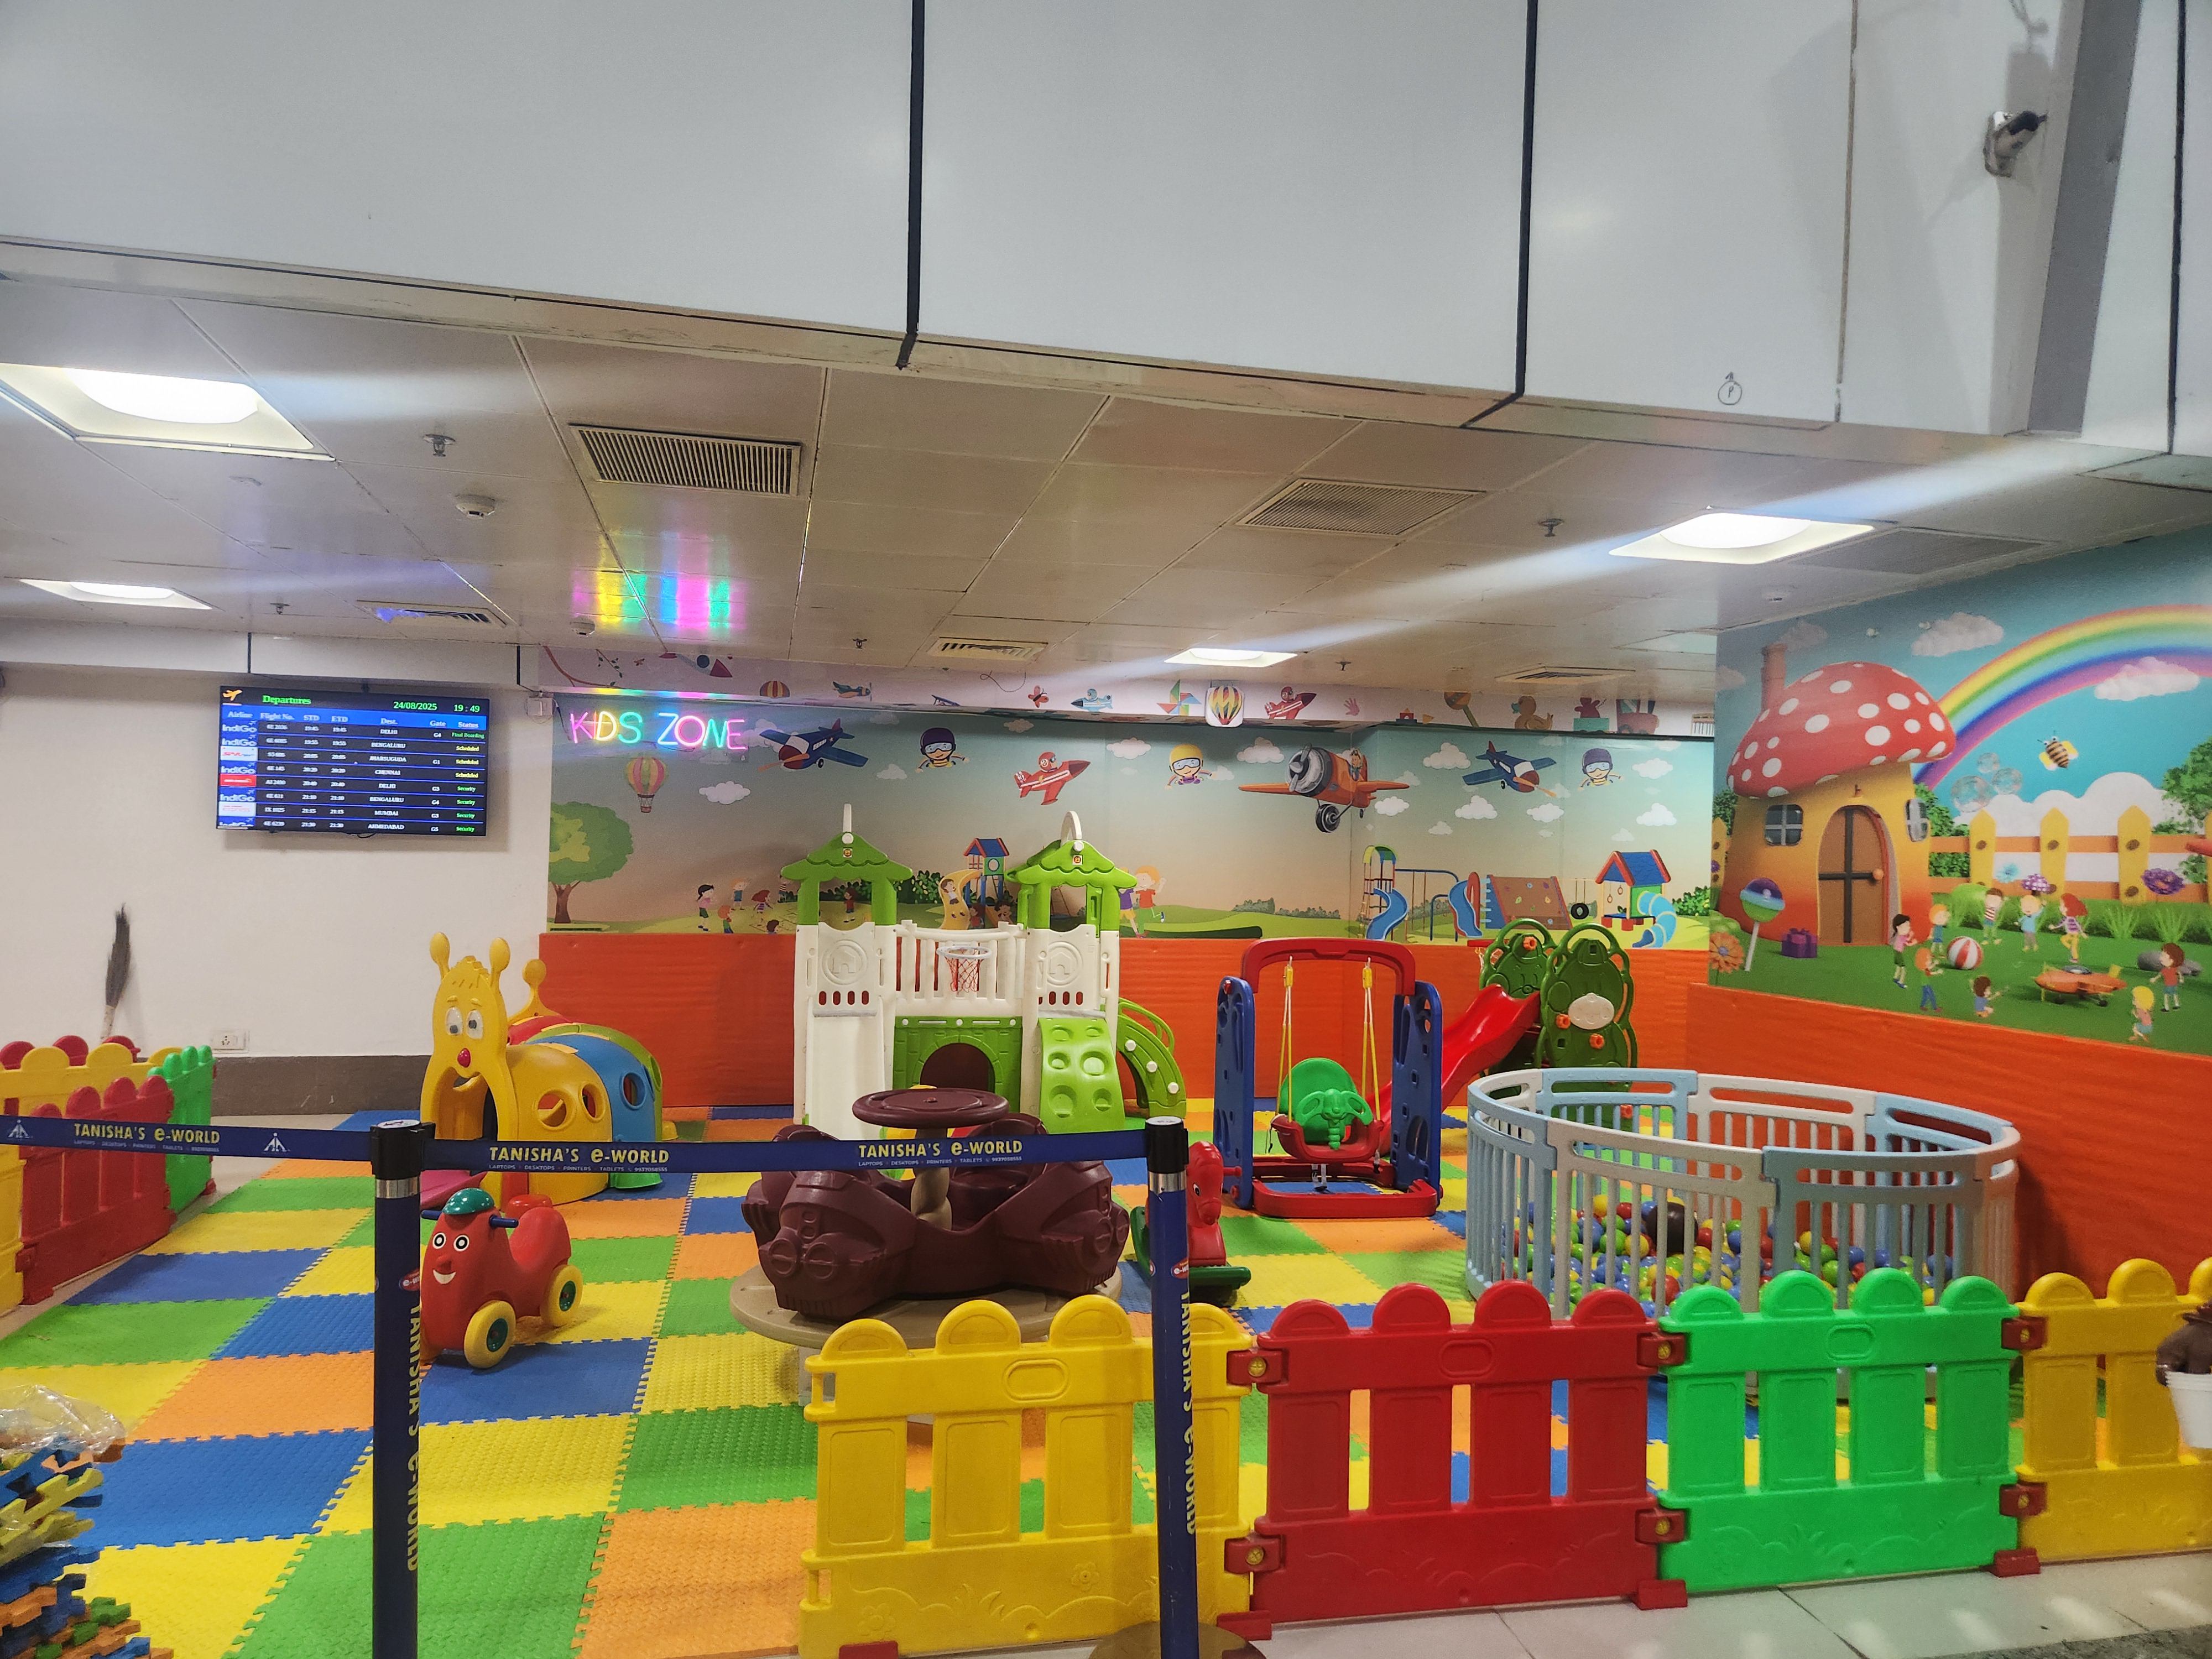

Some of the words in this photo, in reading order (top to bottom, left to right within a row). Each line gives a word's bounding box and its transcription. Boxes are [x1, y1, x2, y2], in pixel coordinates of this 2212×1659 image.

[262, 695, 311, 705] Departures
[393, 701, 437, 711] 24/08/2025
[222, 724, 257, 733] IndiGo
[570, 710, 643, 744] KIDS
[656, 712, 748, 750] ZONE
[222, 738, 257, 747] IndiGo
[221, 766, 256, 774] IndiGo
[220, 794, 255, 802] IndiGo
[74, 1123, 145, 1140] TANISHA'S
[154, 1128, 220, 1144] e-WORLD
[489, 1147, 579, 1162] TANISHA'S
[591, 1148, 669, 1164] e-WORLD
[858, 1142, 941, 1158] TANISHA'S
[951, 1140, 1022, 1156] e-WORLD
[1181, 1291, 1192, 1412] TANISHAS
[409, 1305, 421, 1436] TANISHAS
